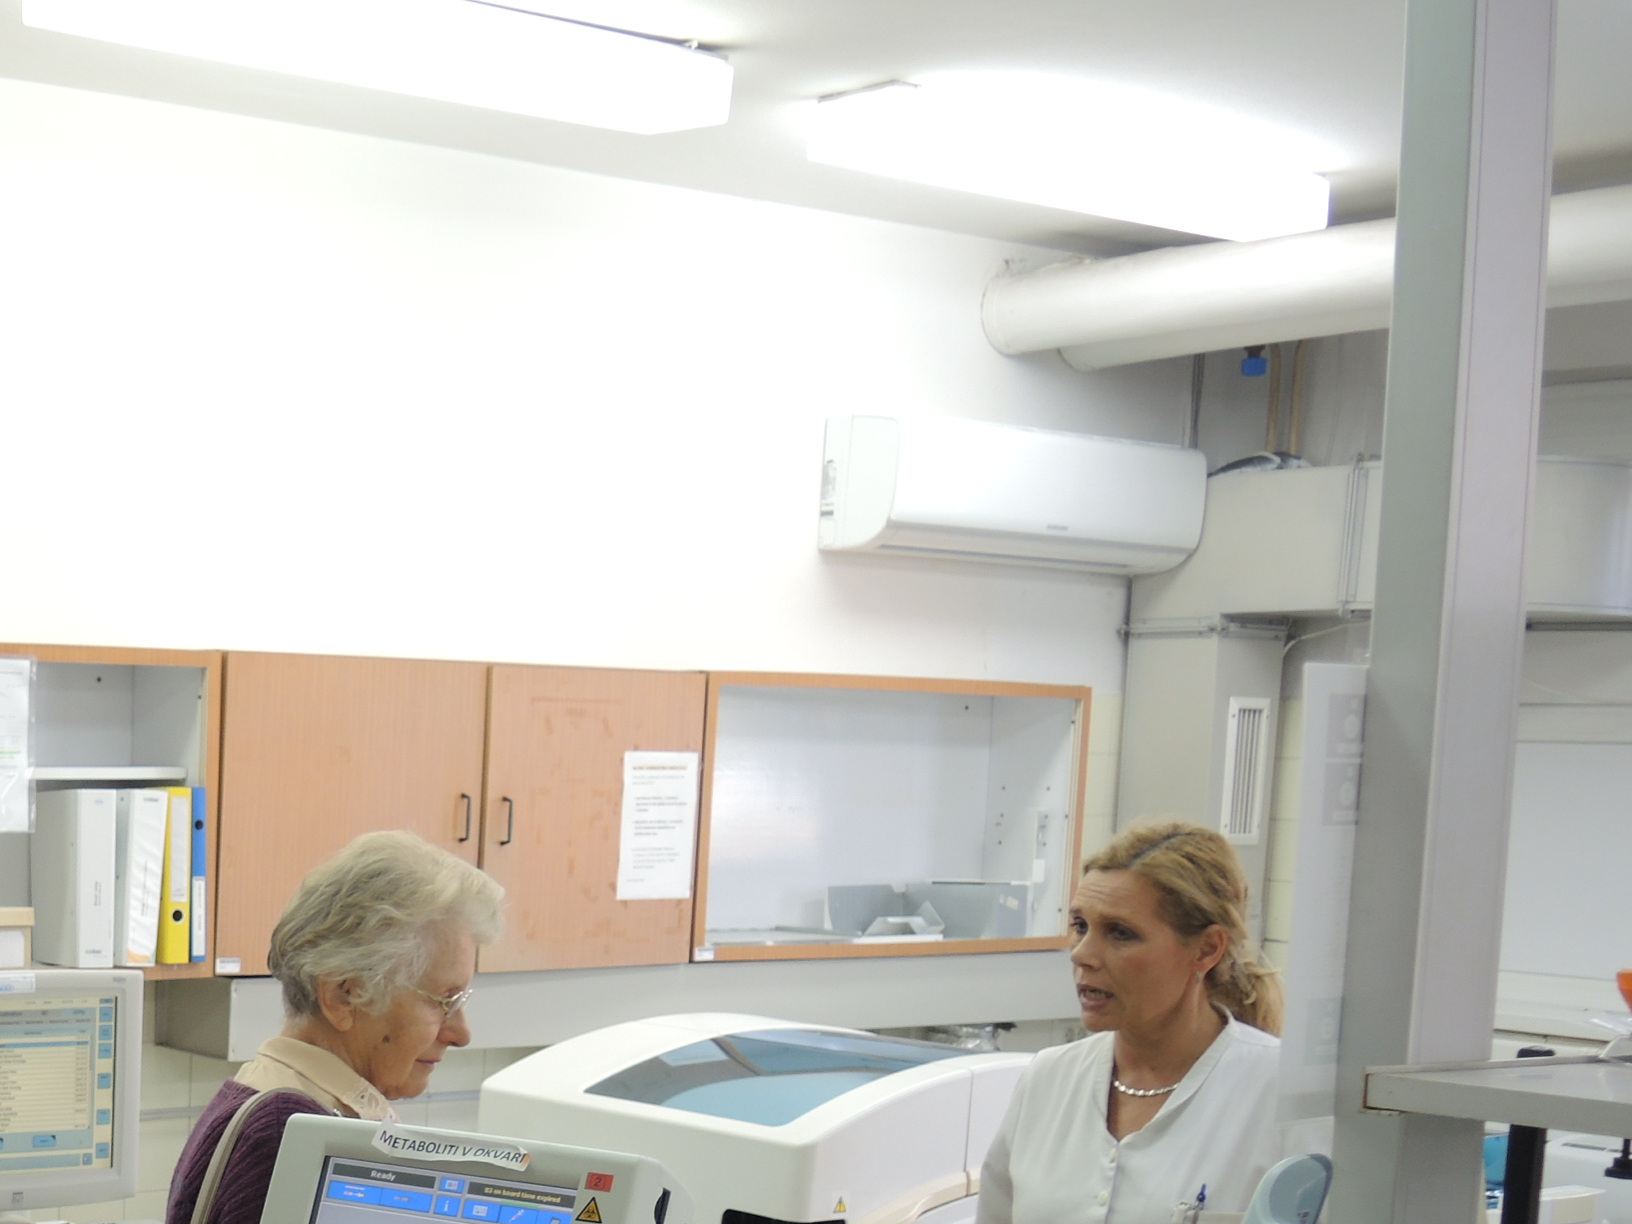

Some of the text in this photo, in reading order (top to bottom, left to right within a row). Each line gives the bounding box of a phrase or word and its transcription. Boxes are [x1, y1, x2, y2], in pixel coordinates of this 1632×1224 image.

[379, 1130, 527, 1165] METABOLITI V OKVARI
[370, 1170, 396, 1182] Ready
[594, 1176, 602, 1188] 2
